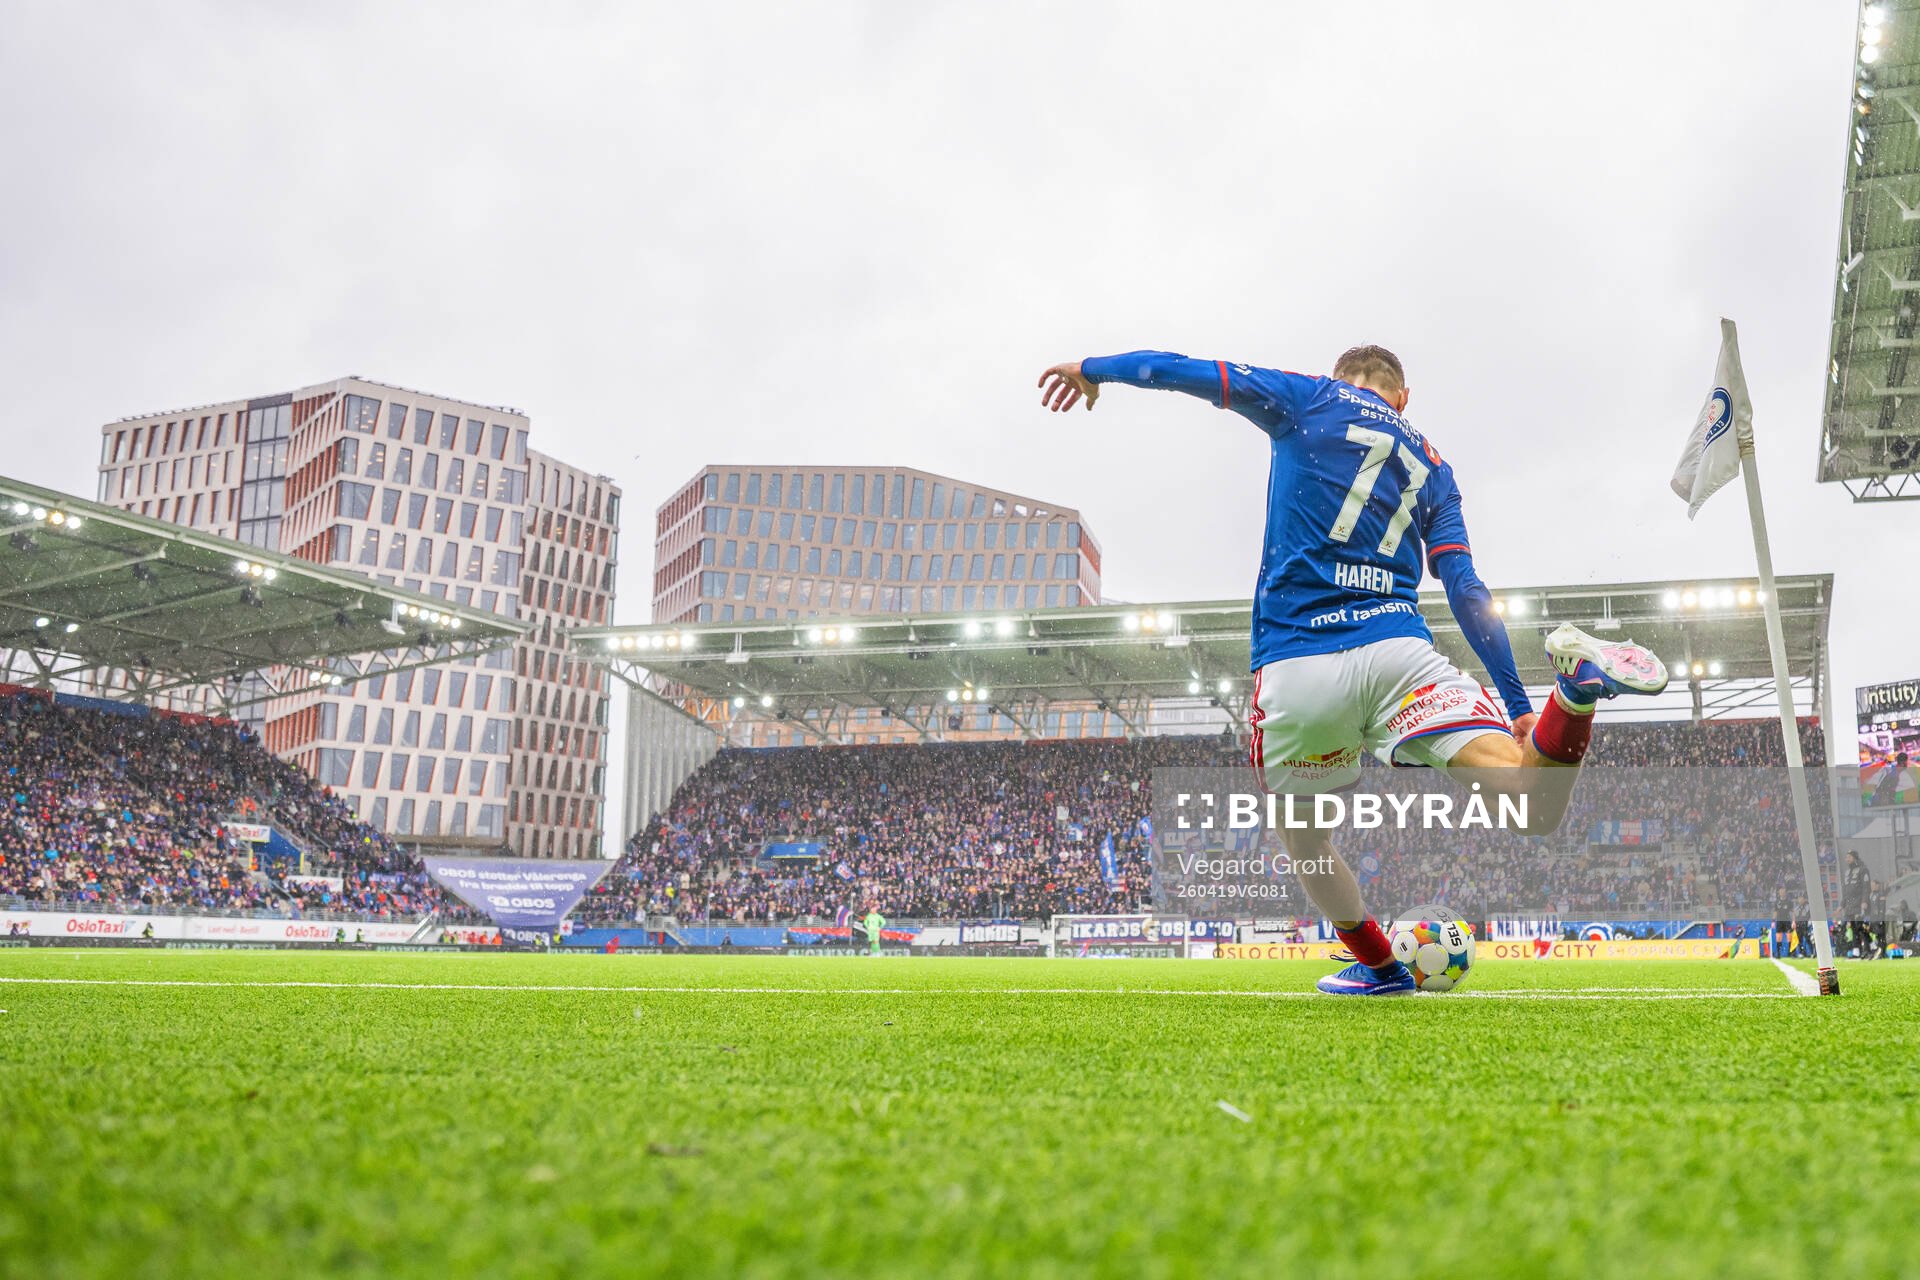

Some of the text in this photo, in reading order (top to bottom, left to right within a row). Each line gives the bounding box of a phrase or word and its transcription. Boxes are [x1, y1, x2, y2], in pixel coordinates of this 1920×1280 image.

[1360, 407, 1422, 448] ØSTLANDET
[1328, 423, 1430, 558] 77
[1334, 562, 1394, 595] HAREN
[1310, 608, 1348, 628] mot
[1863, 684, 1919, 705] intility
[1385, 687, 1465, 733] HURTIGRUTA
[437, 867, 476, 879] OBOS
[458, 879, 480, 889] fra
[510, 897, 556, 909] OBOS
[66, 918, 125, 935] OsloTaxi
[285, 925, 331, 938] OsloTaxi
[1497, 914, 1515, 937] NEI
[1518, 914, 1534, 937] TIL
[1212, 946, 1262, 960] OSLO
[1267, 946, 1310, 960] CITY
[1495, 944, 1531, 958] OSL
[1552, 944, 1598, 958] CITY
